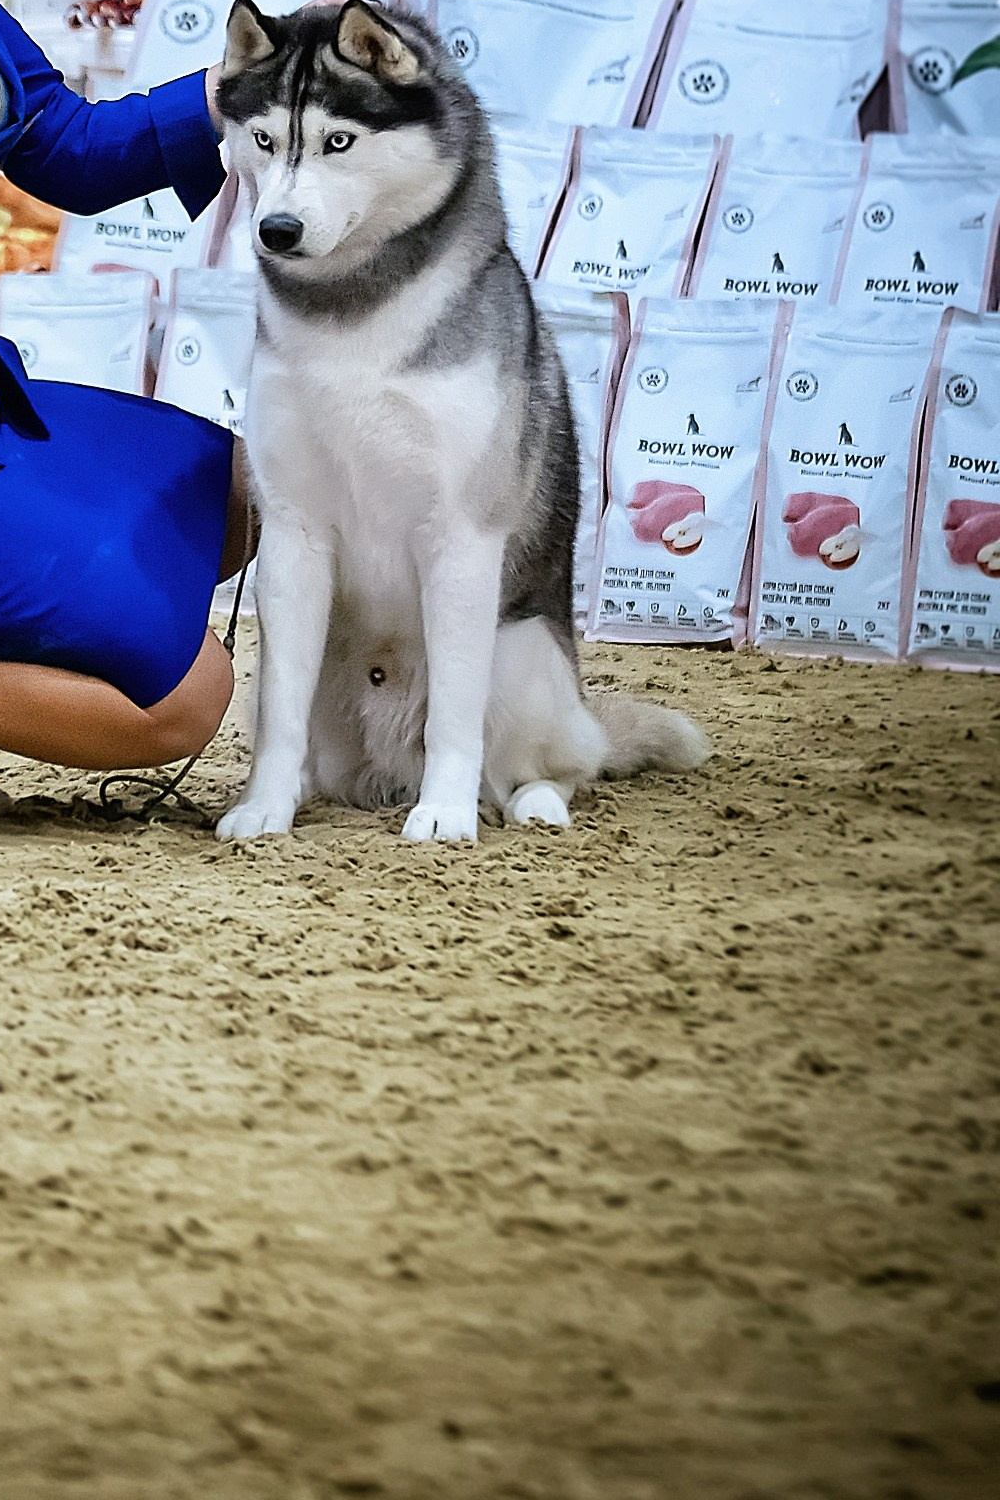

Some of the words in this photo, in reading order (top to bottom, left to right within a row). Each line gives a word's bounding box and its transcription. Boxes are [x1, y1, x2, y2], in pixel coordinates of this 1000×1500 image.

[96, 222, 141, 239] BOWL
[147, 227, 186, 243] WOW
[573, 261, 613, 277] BOWL
[724, 278, 771, 294] BOWL
[776, 281, 818, 296] WOW
[865, 278, 911, 293] BOWL
[917, 281, 959, 296] WOW
[637, 439, 686, 455] BOWL
[691, 442, 735, 460] WOW
[789, 449, 839, 466] BOWL
[844, 453, 886, 469] WOW
[948, 454, 1000, 474] BOWL
